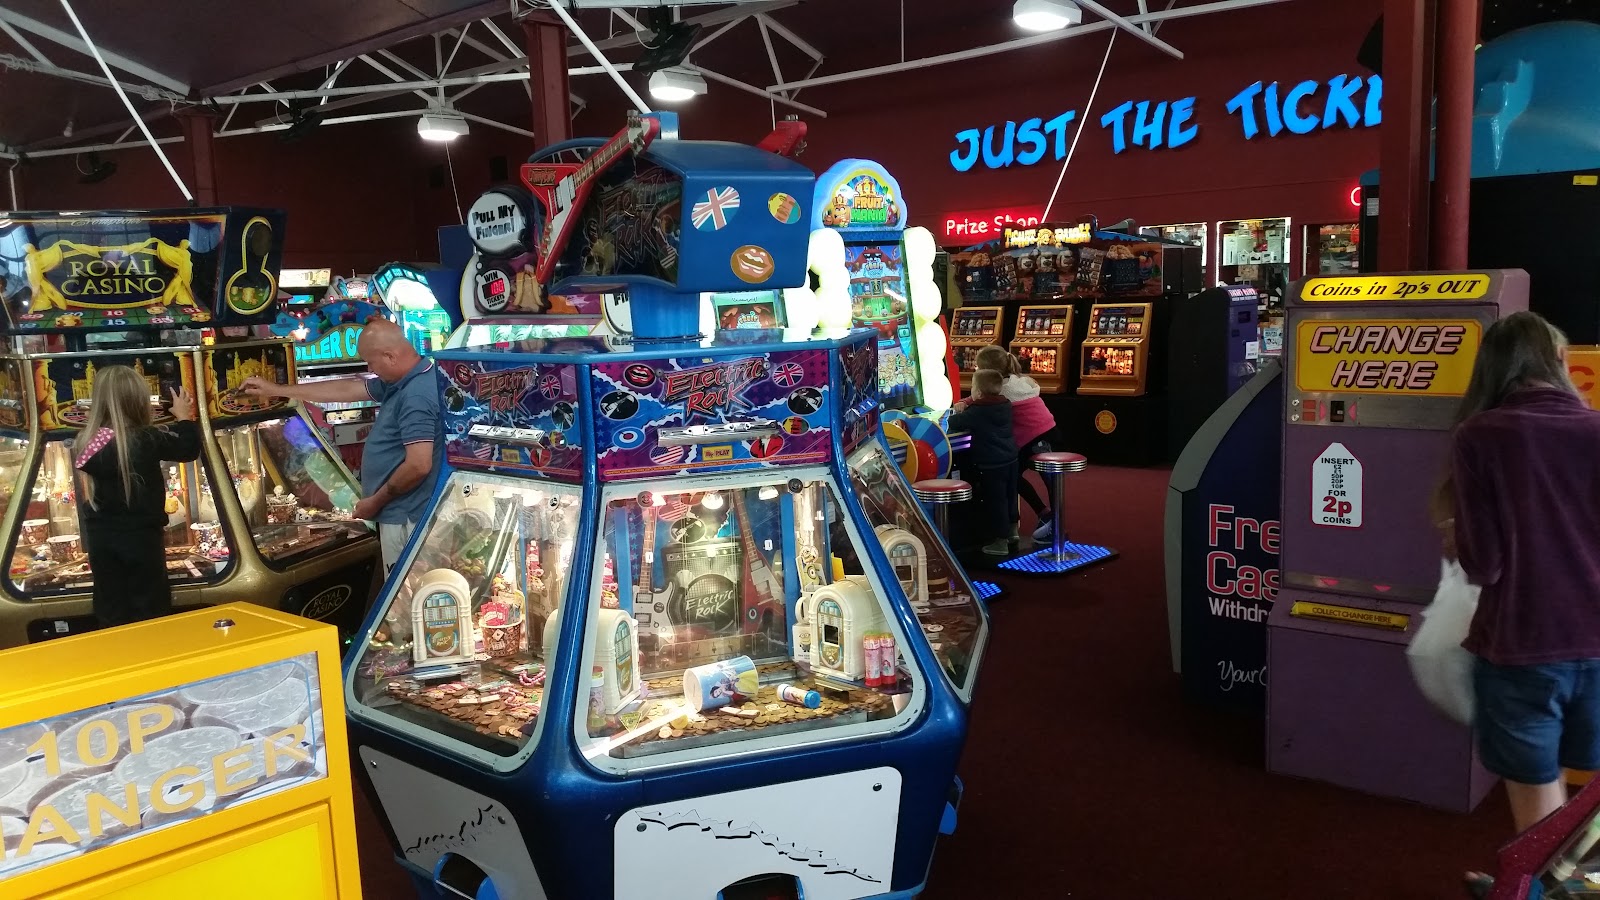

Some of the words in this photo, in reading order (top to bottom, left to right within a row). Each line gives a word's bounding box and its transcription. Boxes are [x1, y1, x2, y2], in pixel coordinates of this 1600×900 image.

[950, 109, 1076, 172] JUST
[1101, 96, 1199, 155] THE
[854, 196, 884, 209] FRUIT
[472, 210, 496, 225] PULL
[498, 204, 516, 219] MY
[946, 217, 988, 236] Prize
[69, 259, 157, 277] ROYAL
[484, 271, 499, 283] WIN
[61, 277, 166, 296] CASINO
[1310, 281, 1363, 297] Coins
[1367, 281, 1388, 296] in
[1393, 280, 1431, 298] 2p's
[1437, 279, 1481, 294] OUT
[106, 318, 126, 326] 15
[1310, 325, 1467, 355] CHANGE
[1331, 359, 1438, 389] HERE
[1322, 496, 1352, 517] 2p
[1322, 517, 1352, 525] COINS
[308, 597, 342, 618] CASINO
[314, 589, 341, 608] ROYAL
[1312, 607, 1341, 617] COLLECT
[1342, 611, 1373, 621] CHANGE
[1374, 615, 1392, 624] HERE
[26, 704, 175, 778] 10P
[0, 724, 308, 862] ANGER
